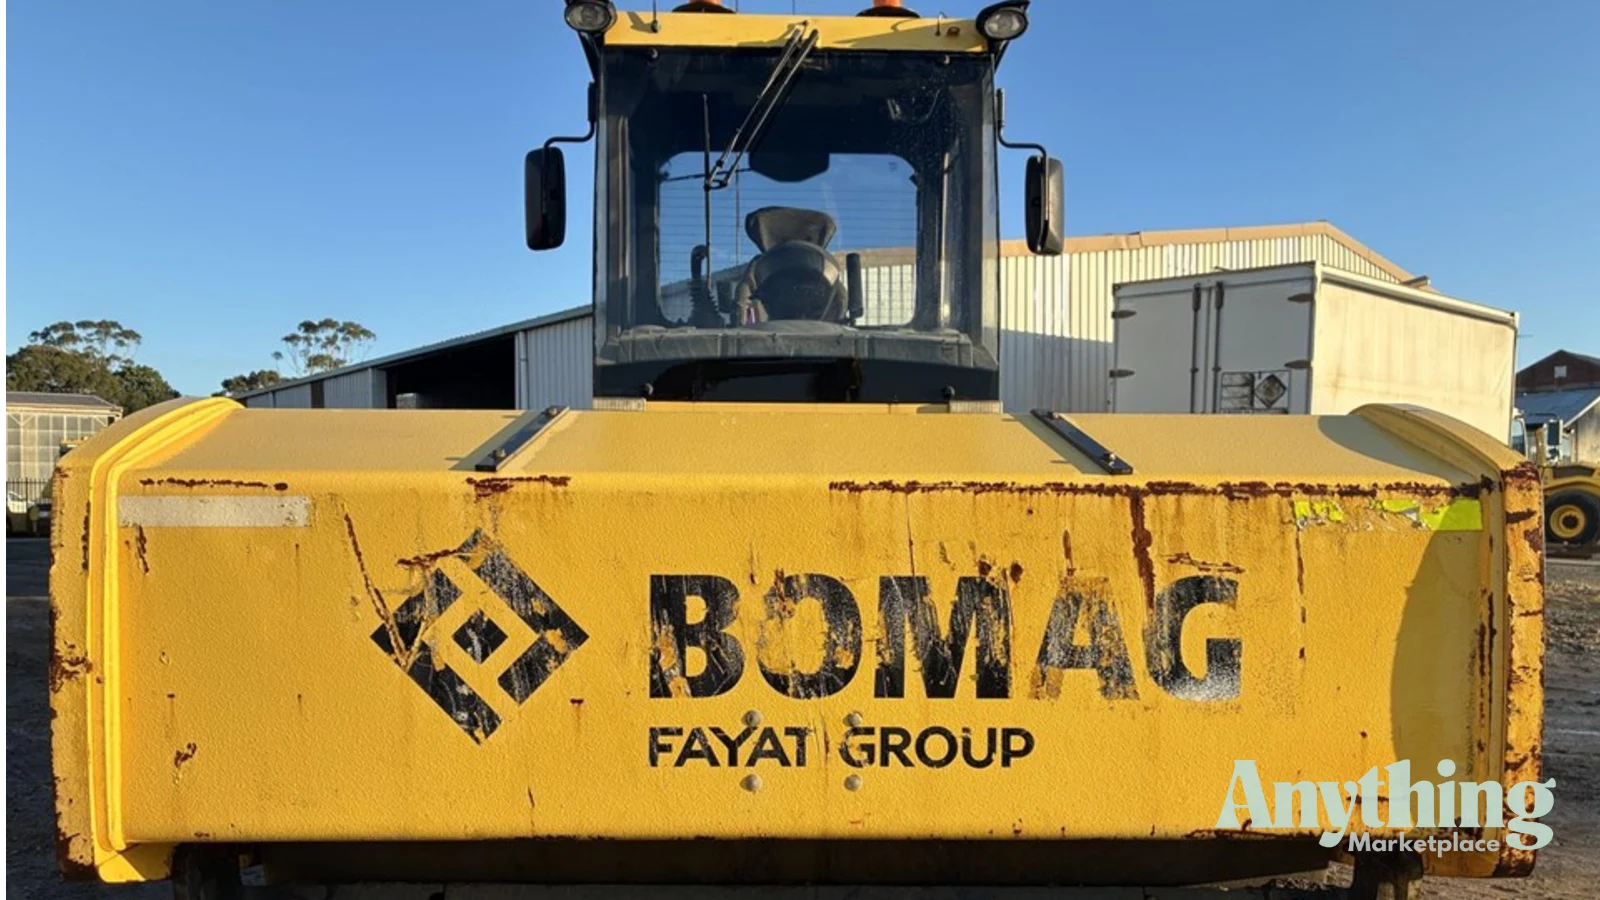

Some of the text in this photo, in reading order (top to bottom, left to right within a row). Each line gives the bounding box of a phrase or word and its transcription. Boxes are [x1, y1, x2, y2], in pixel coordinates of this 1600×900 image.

[649, 573, 1242, 701] BOMAG
[648, 725, 1035, 769] FAYAT GROUP
